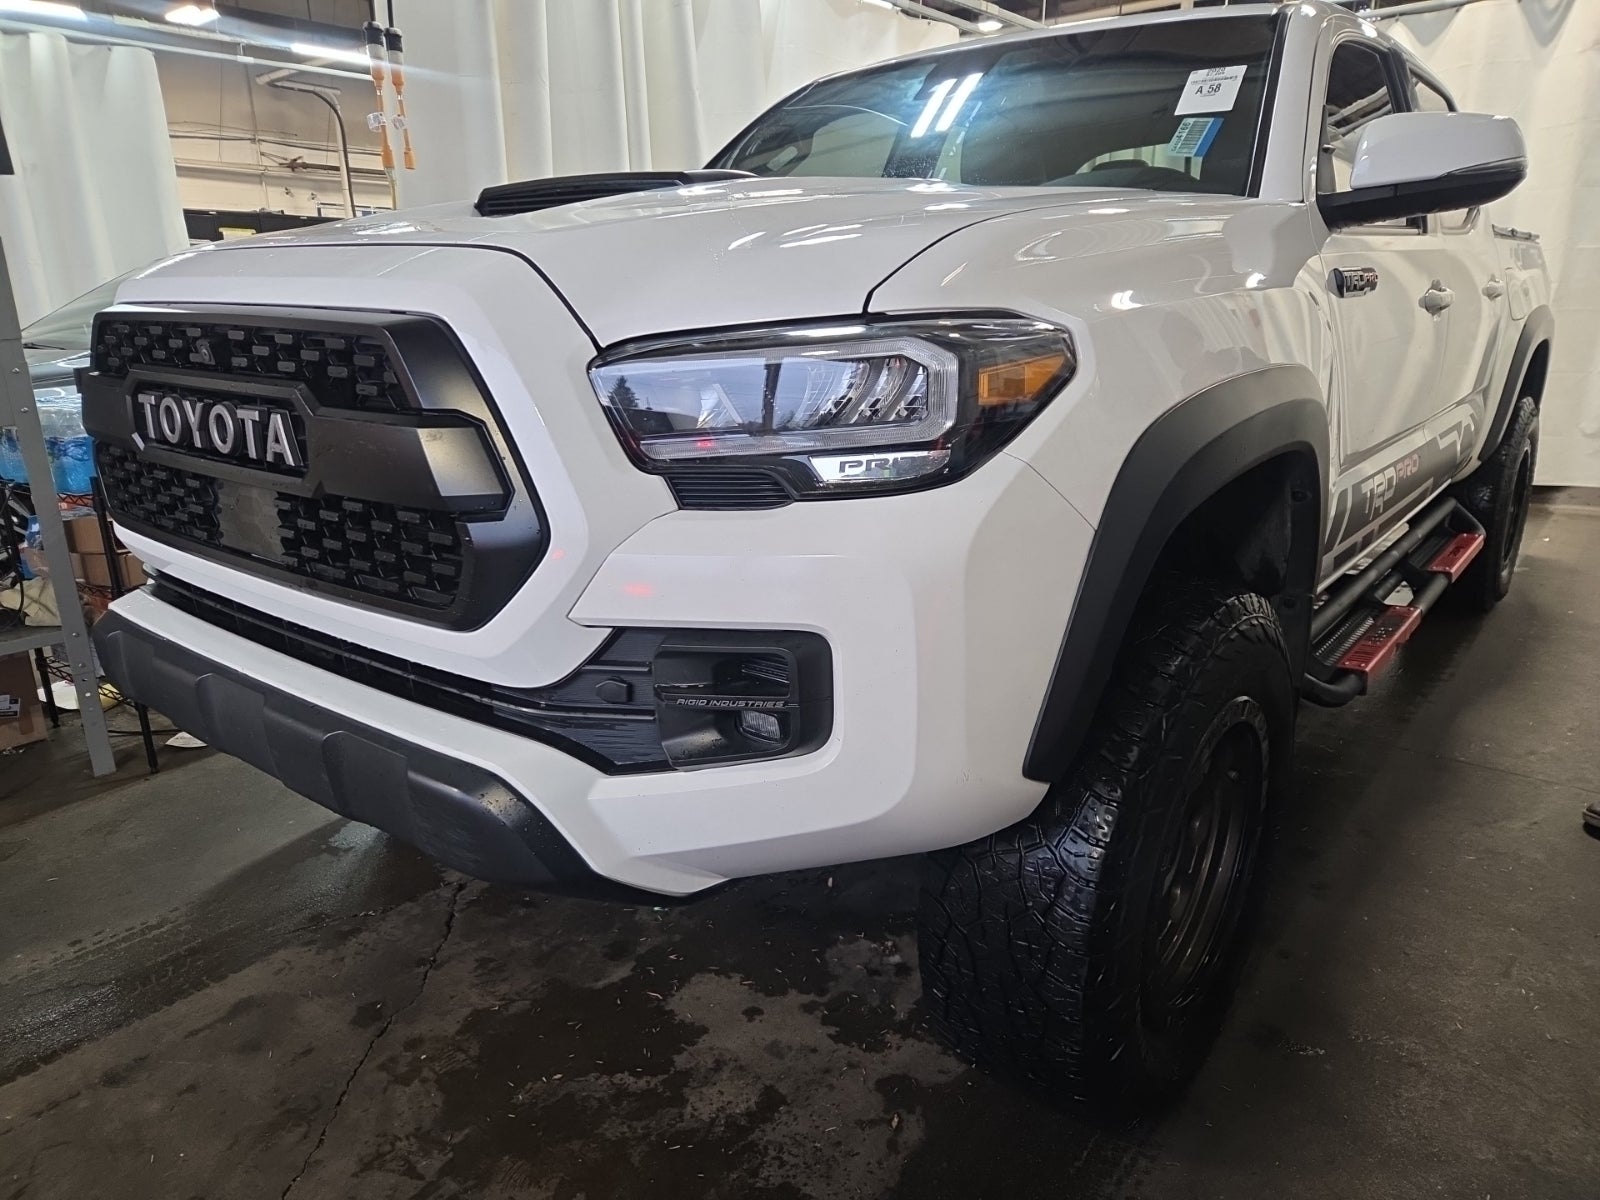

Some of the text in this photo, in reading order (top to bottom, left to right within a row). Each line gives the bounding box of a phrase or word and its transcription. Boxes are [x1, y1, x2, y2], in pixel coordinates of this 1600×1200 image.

[1195, 83, 1221, 94] A 58
[137, 392, 296, 467] TOYOTA
[1361, 453, 1420, 520] TRD PRO
[676, 698, 785, 708] RIGID INDUSTRIES
